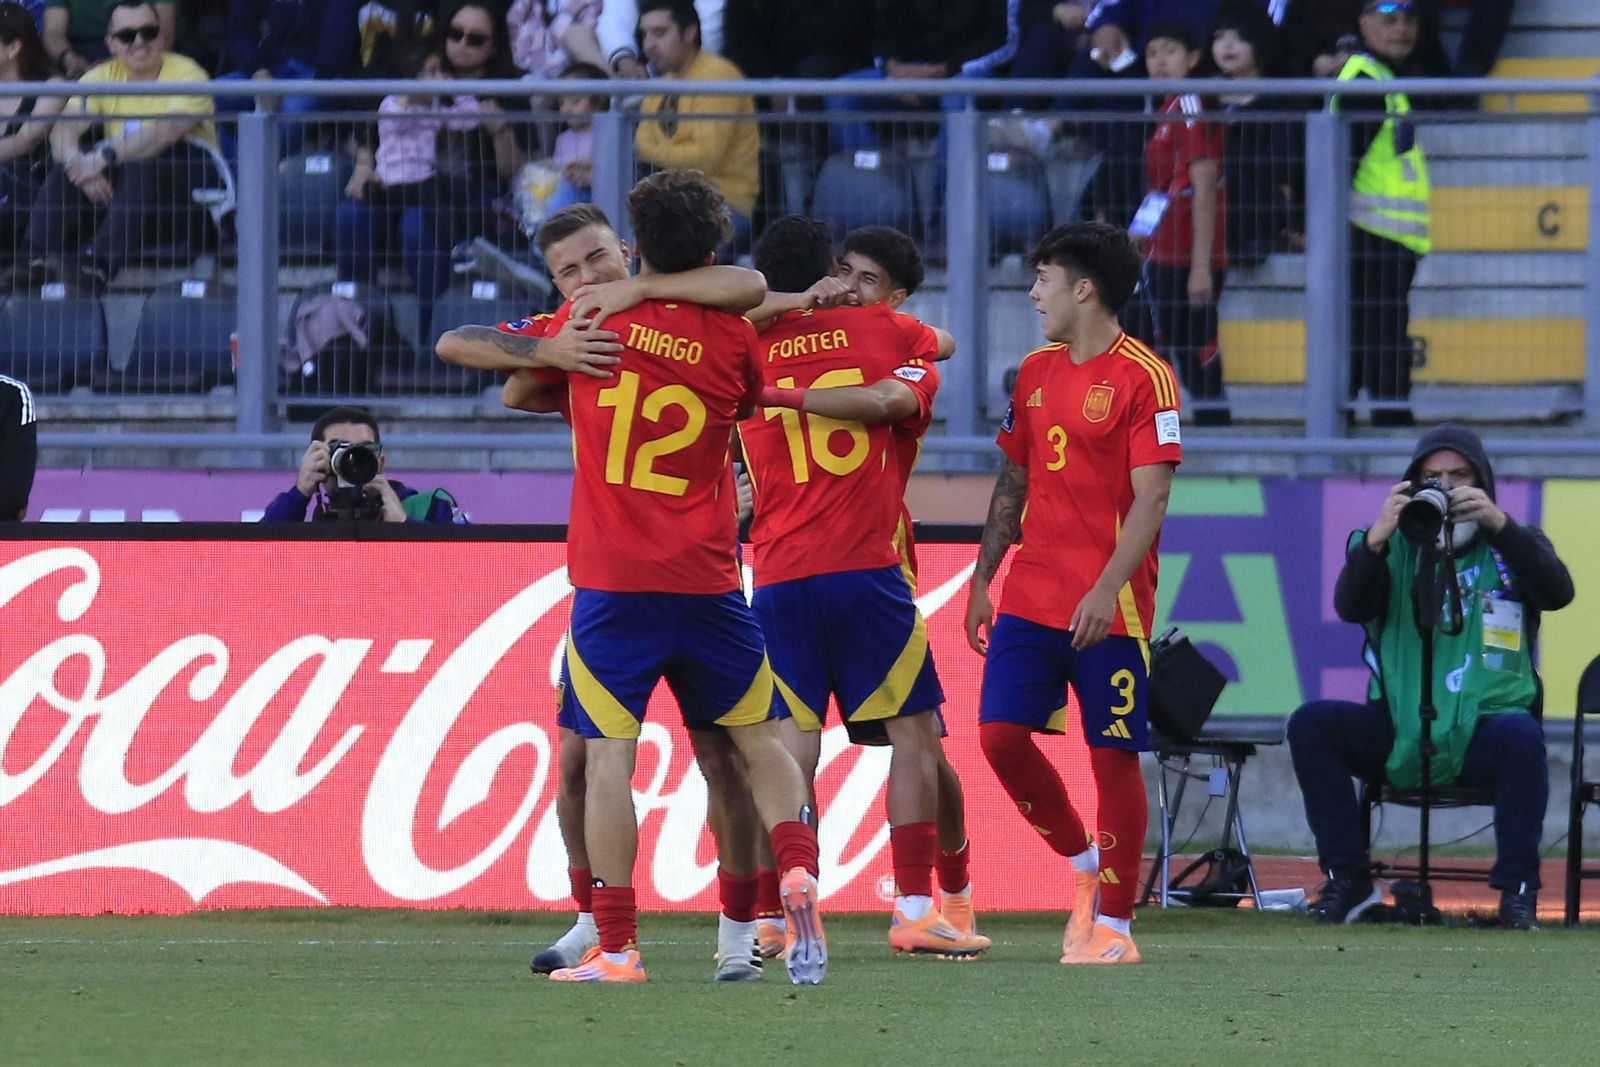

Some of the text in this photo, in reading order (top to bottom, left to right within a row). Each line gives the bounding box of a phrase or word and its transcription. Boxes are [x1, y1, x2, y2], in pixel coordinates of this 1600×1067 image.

[1537, 202, 1560, 237] C
[627, 322, 704, 366] THIAGO
[768, 327, 849, 362] FORTEA
[597, 369, 708, 497] 12
[764, 367, 870, 484] 16
[1046, 424, 1068, 472] 3
[1110, 669, 1135, 715] 3
